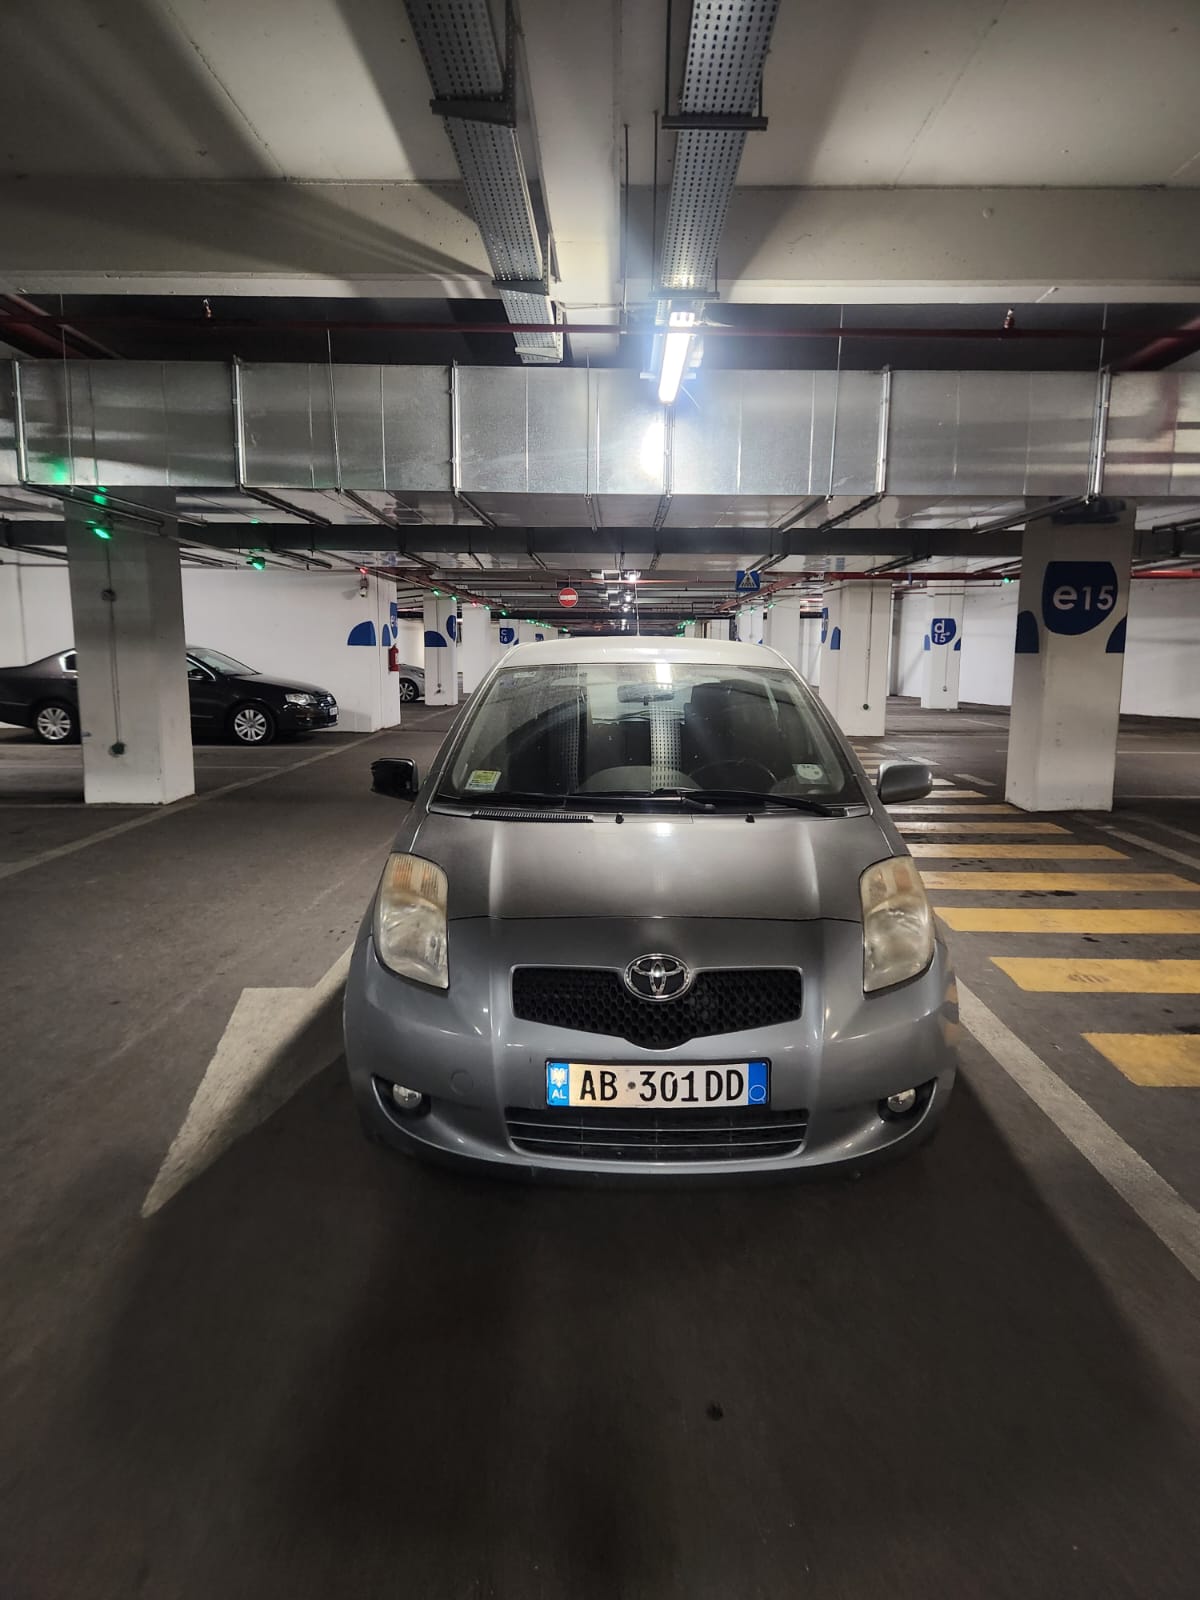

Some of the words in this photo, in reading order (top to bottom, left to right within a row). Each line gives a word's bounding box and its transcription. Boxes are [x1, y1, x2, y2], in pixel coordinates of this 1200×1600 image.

[1053, 586, 1113, 611] e15
[934, 620, 944, 633] d
[934, 633, 945, 642] 15
[580, 1070, 617, 1101] AB
[551, 1088, 567, 1099] AL
